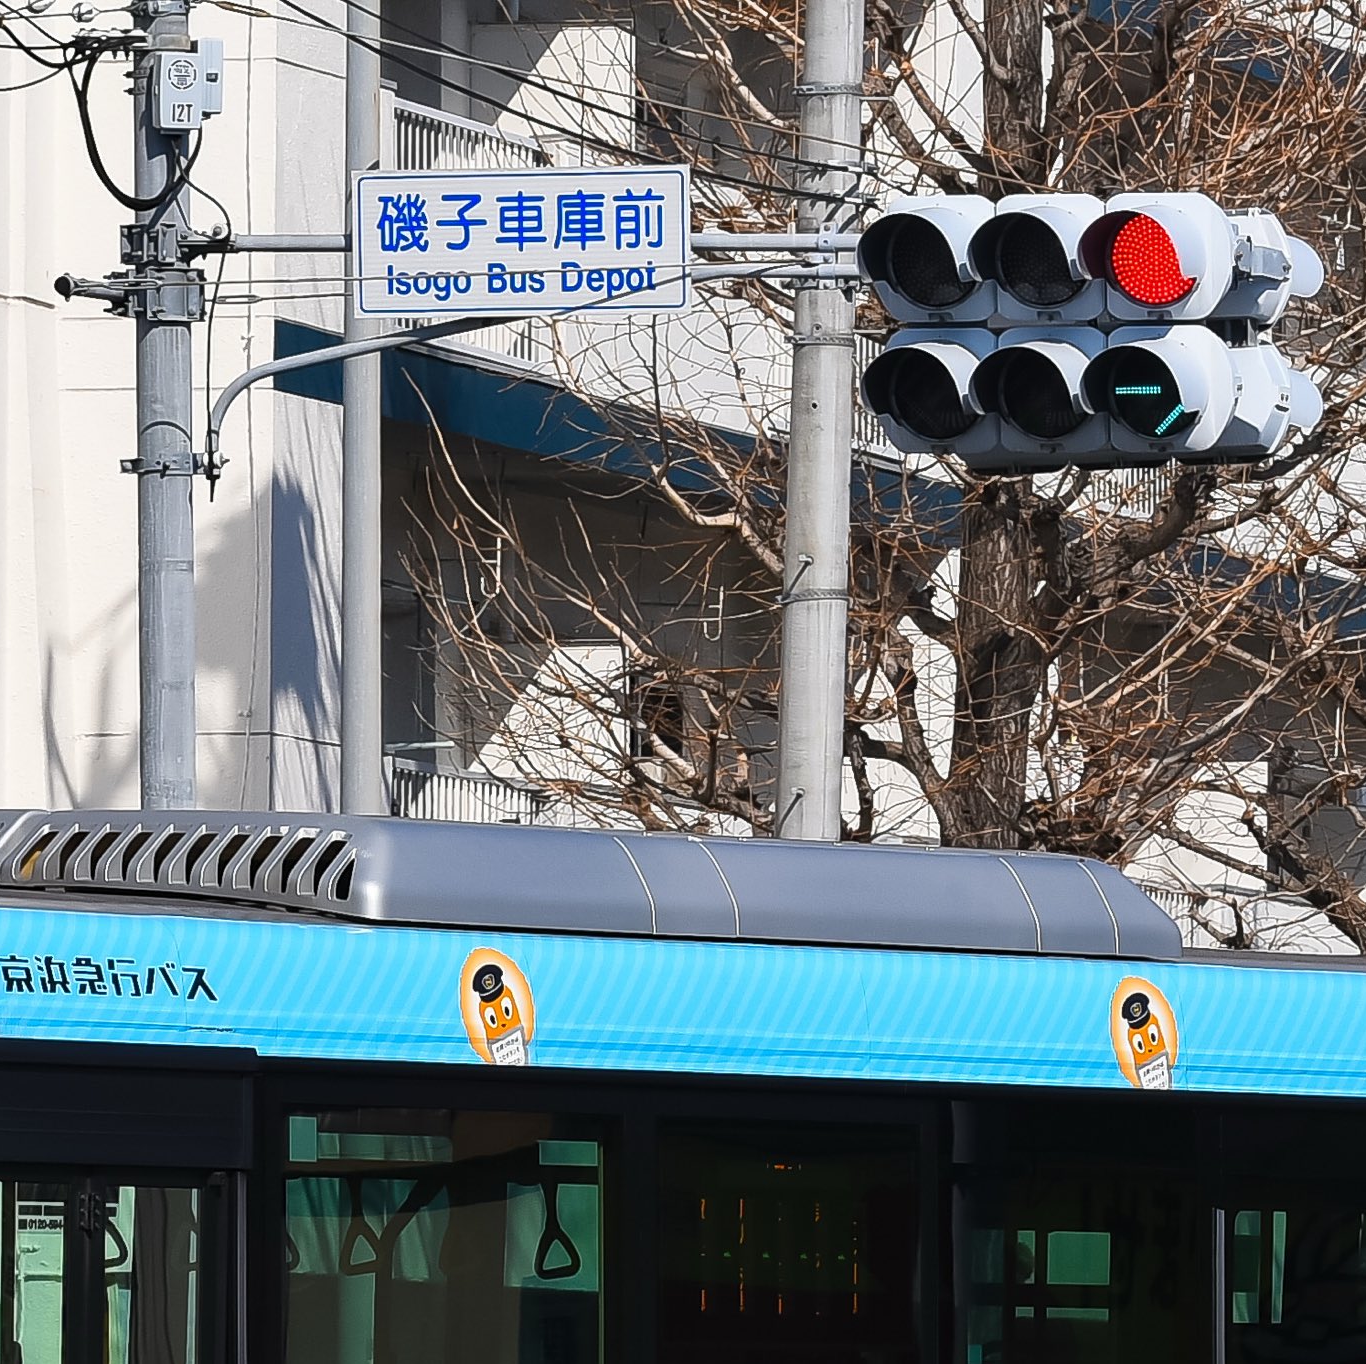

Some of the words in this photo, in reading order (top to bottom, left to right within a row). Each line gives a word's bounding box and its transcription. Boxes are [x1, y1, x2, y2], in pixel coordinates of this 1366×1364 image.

[377, 188, 665, 252] 磯子車庫前
[387, 264, 472, 301] Isogo
[488, 263, 545, 293] Bus
[561, 261, 656, 300] Depot
[0, 954, 218, 1003] 京浜急行バス
